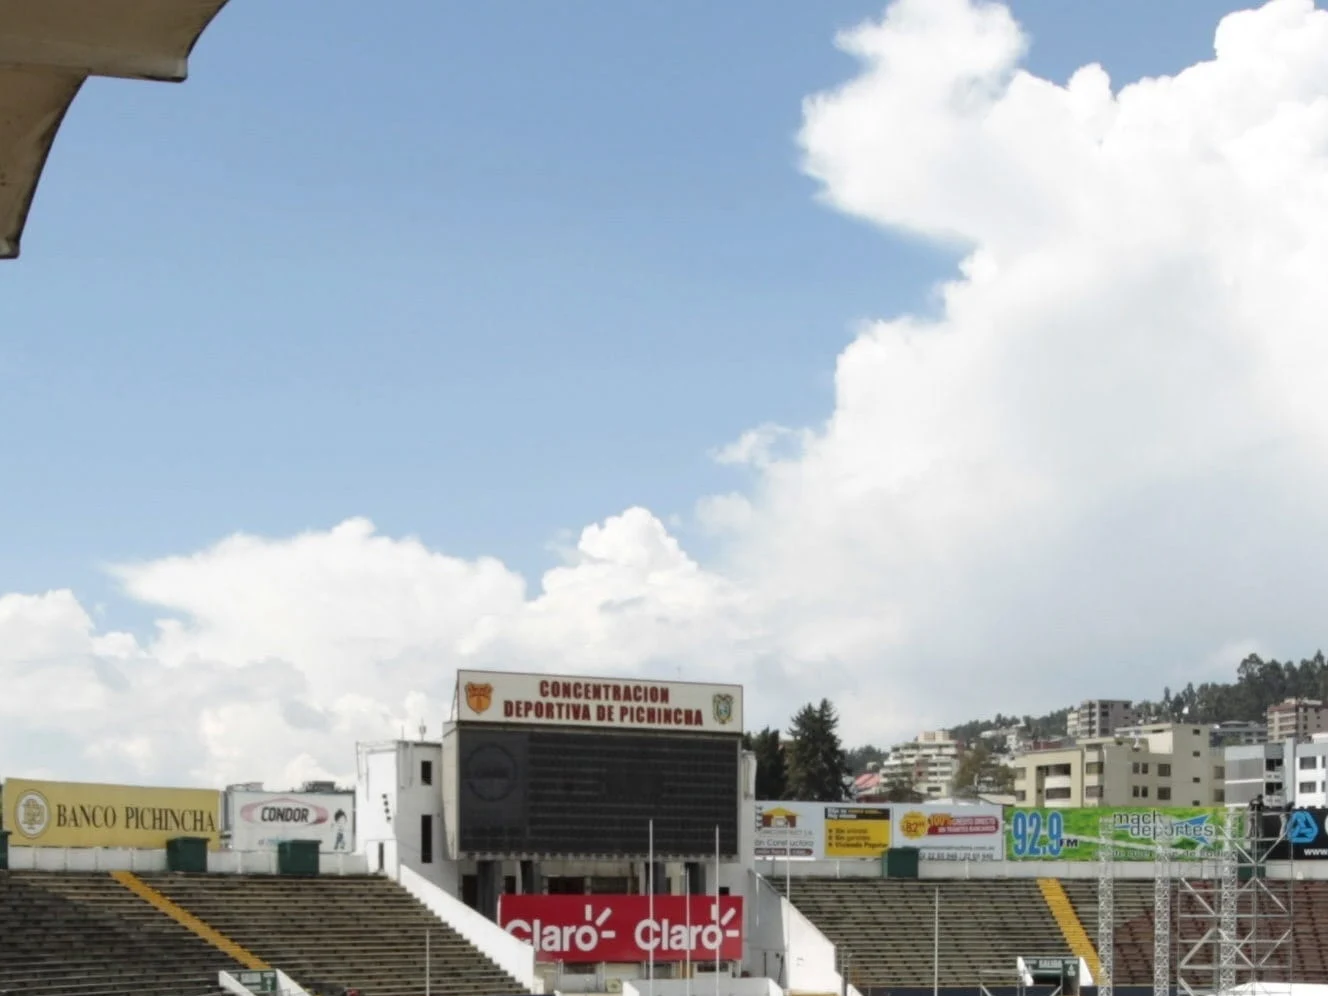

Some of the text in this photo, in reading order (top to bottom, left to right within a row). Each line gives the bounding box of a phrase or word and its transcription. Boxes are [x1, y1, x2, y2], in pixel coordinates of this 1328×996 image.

[539, 680, 669, 704] CONCENTRACION
[503, 700, 703, 726] DEPORTIVA DE PICHINCHA
[56, 804, 216, 832] BANCO PICHINCHA
[261, 807, 309, 822] CONDOR
[1012, 811, 1078, 856] 92.9 FM
[1130, 822, 1214, 841] deportes
[504, 918, 722, 951] Claro Claro
